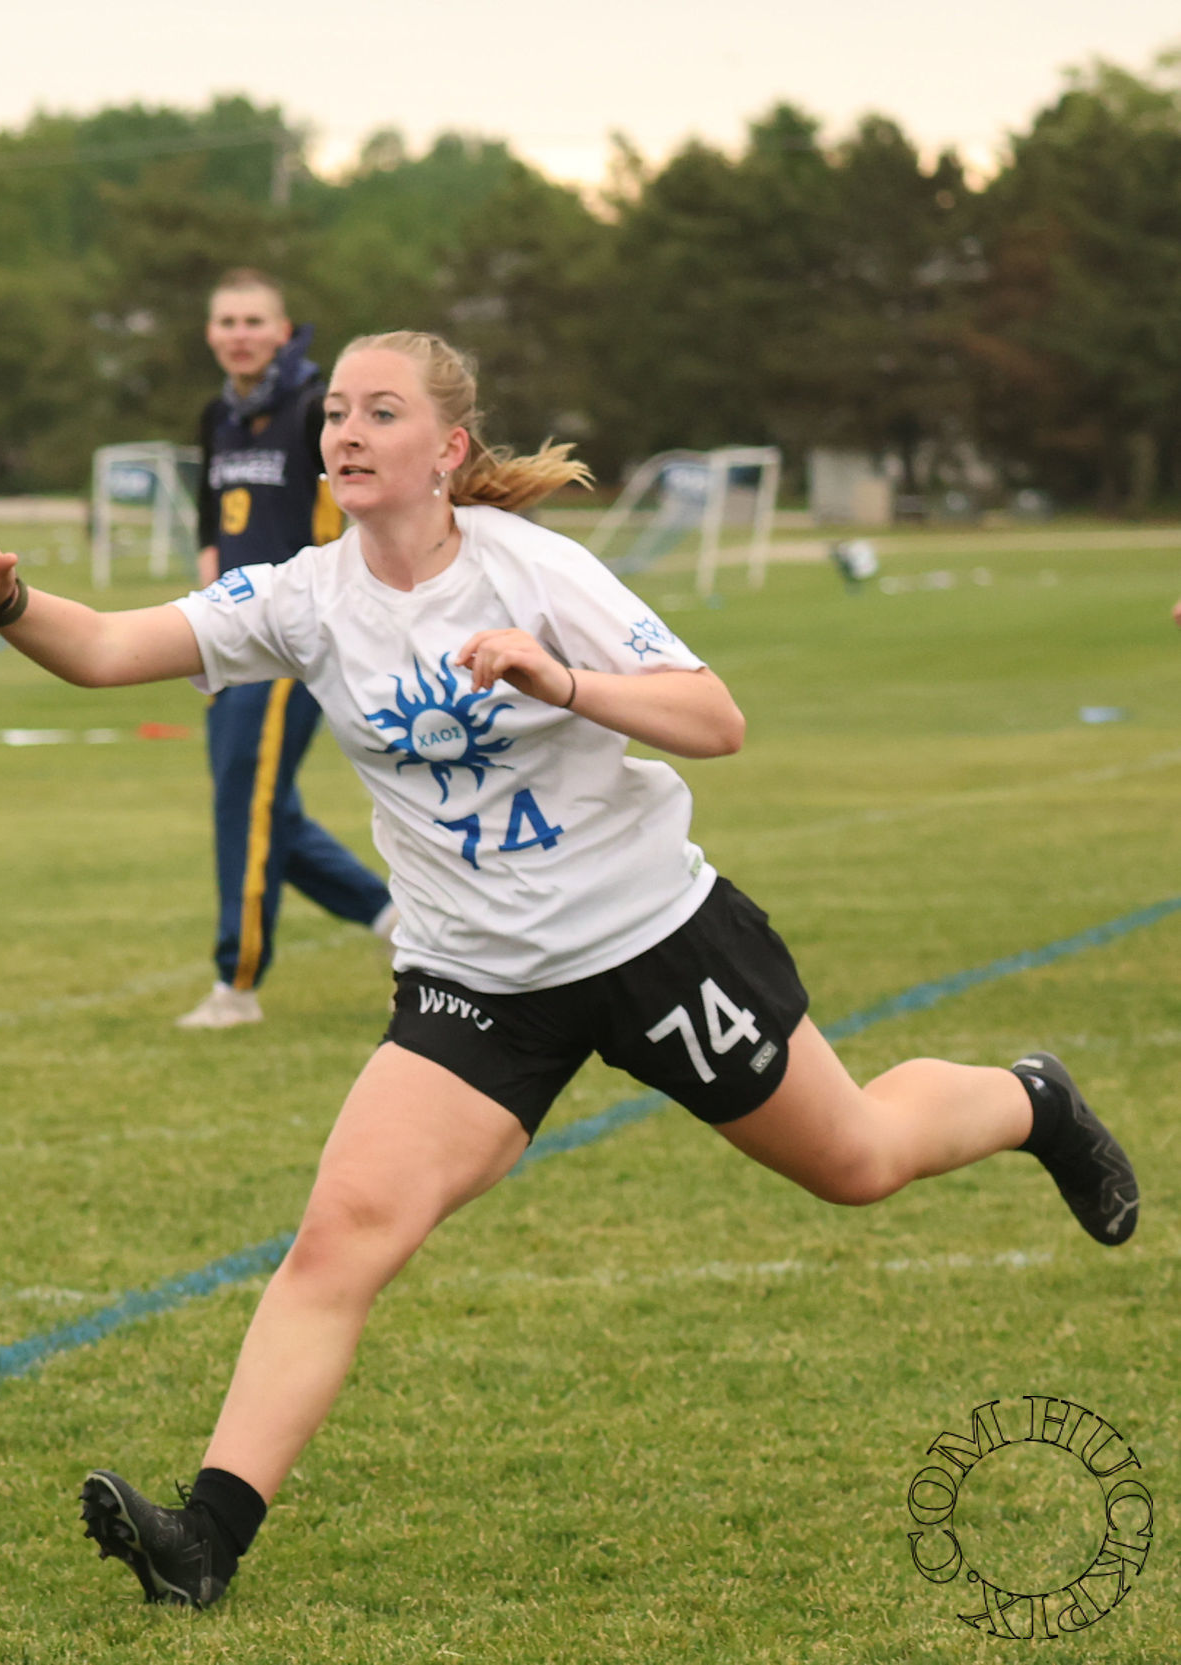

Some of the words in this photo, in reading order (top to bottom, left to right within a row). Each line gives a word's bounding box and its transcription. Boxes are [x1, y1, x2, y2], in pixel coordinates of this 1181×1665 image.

[434, 788, 564, 870] 74
[418, 984, 495, 1032] WWU
[645, 976, 762, 1084] 74
